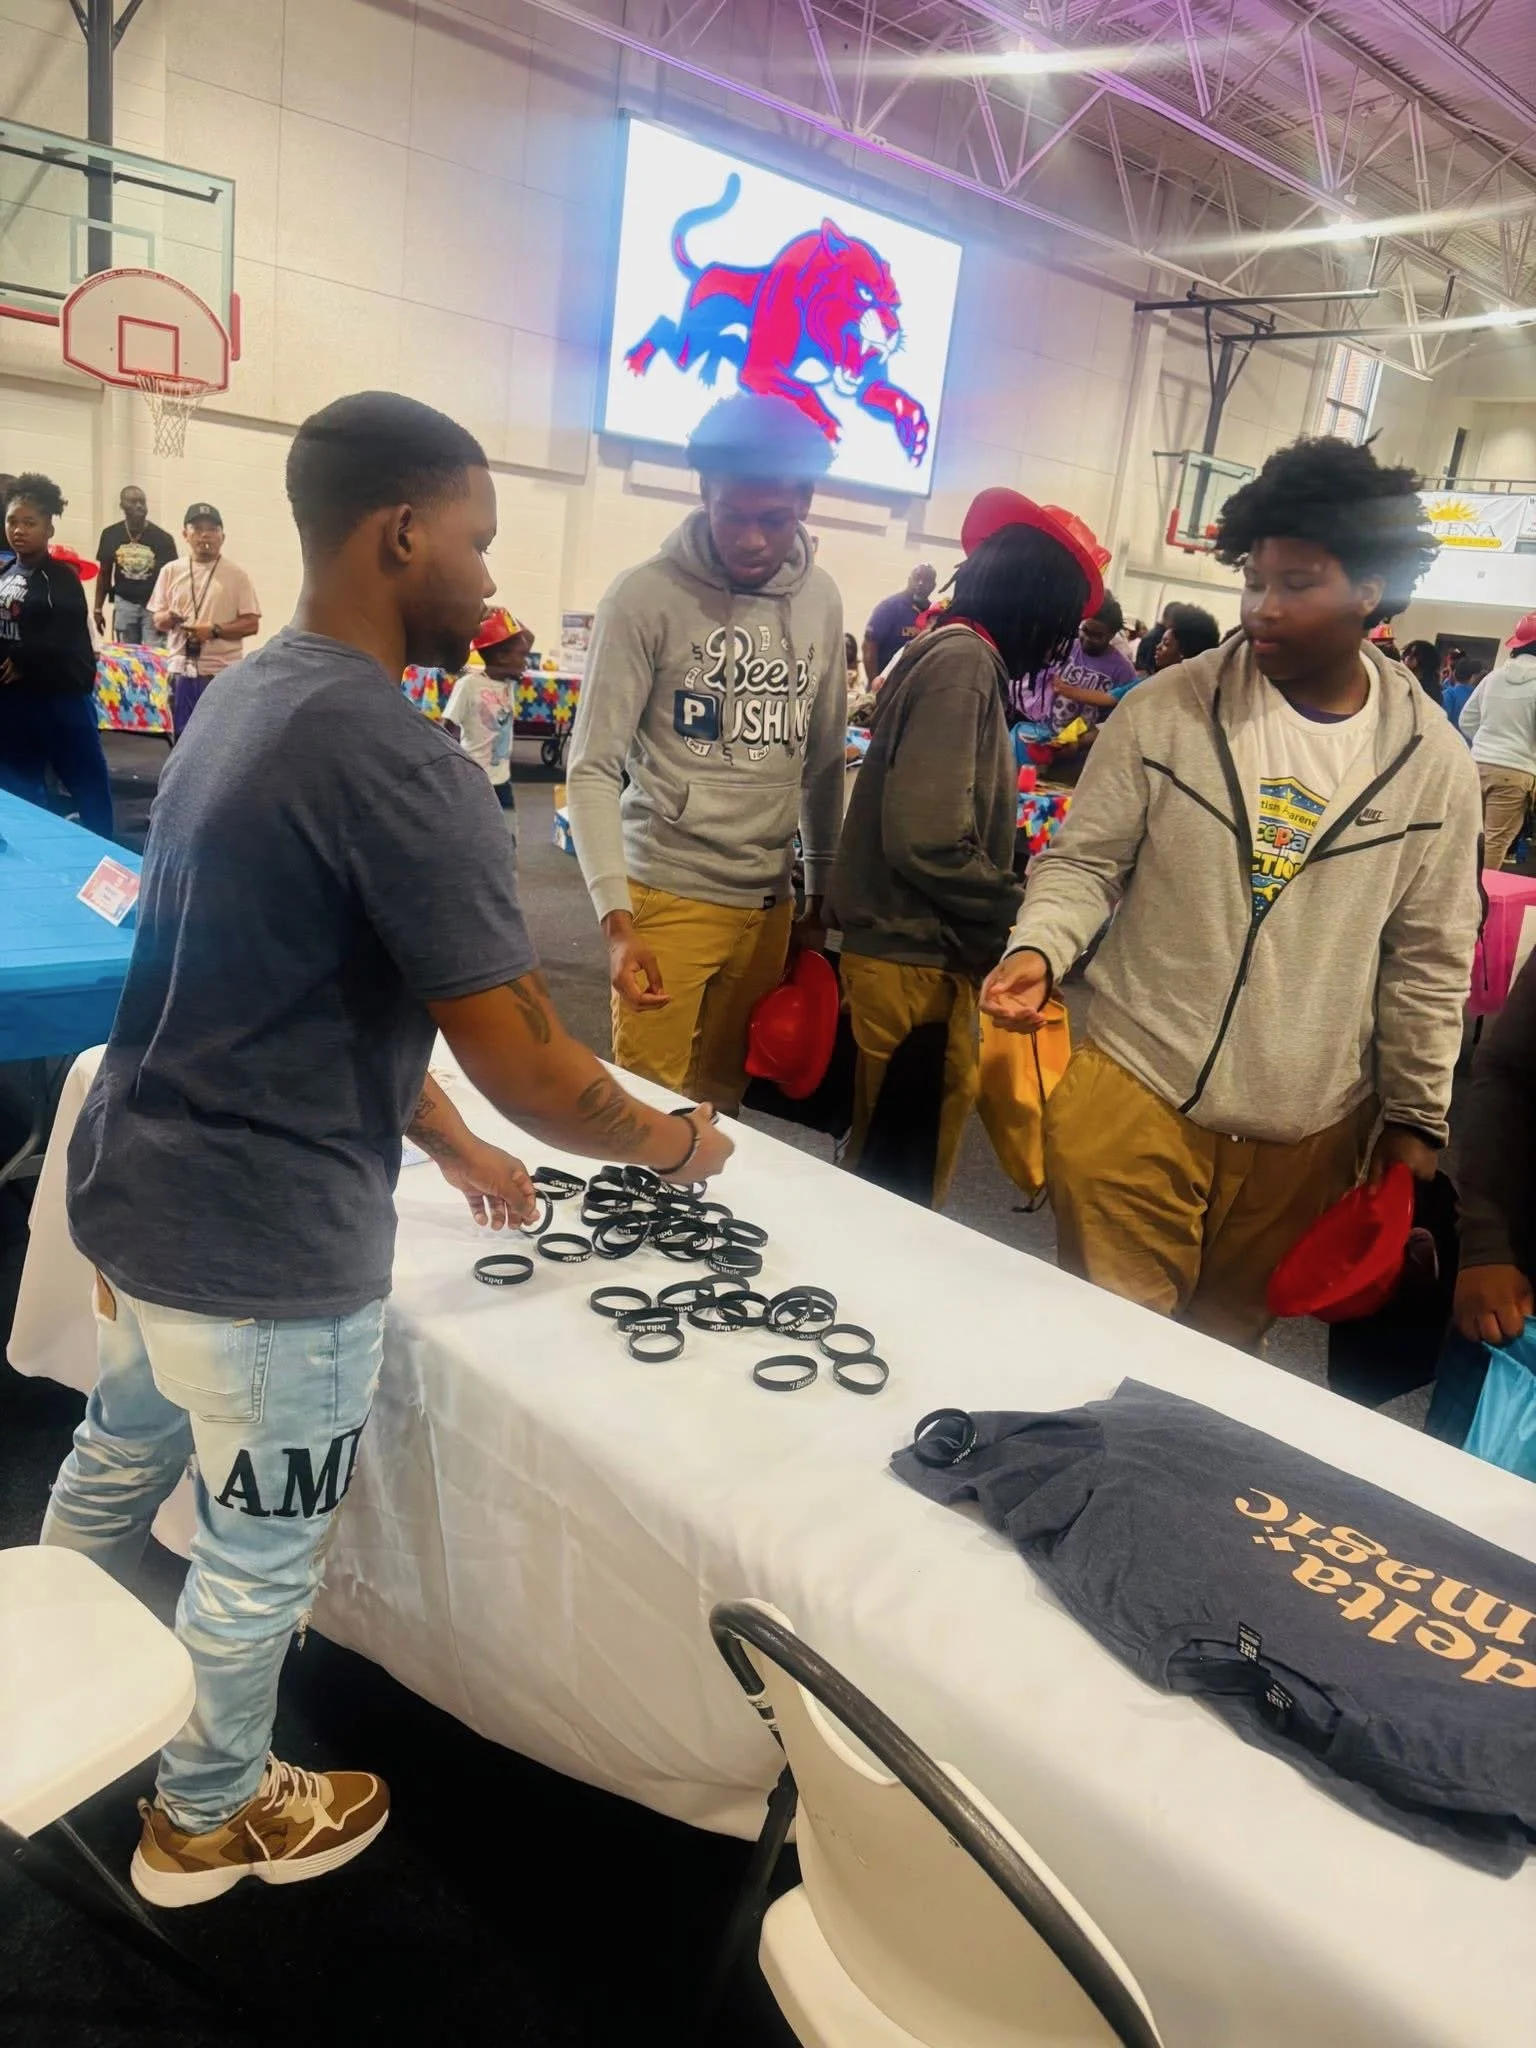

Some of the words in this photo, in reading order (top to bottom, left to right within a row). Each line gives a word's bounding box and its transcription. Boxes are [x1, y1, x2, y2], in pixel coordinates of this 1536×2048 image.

[1260, 800, 1281, 813] tism
[1235, 1487, 1536, 1645] magic
[1292, 1554, 1536, 1688] delta
